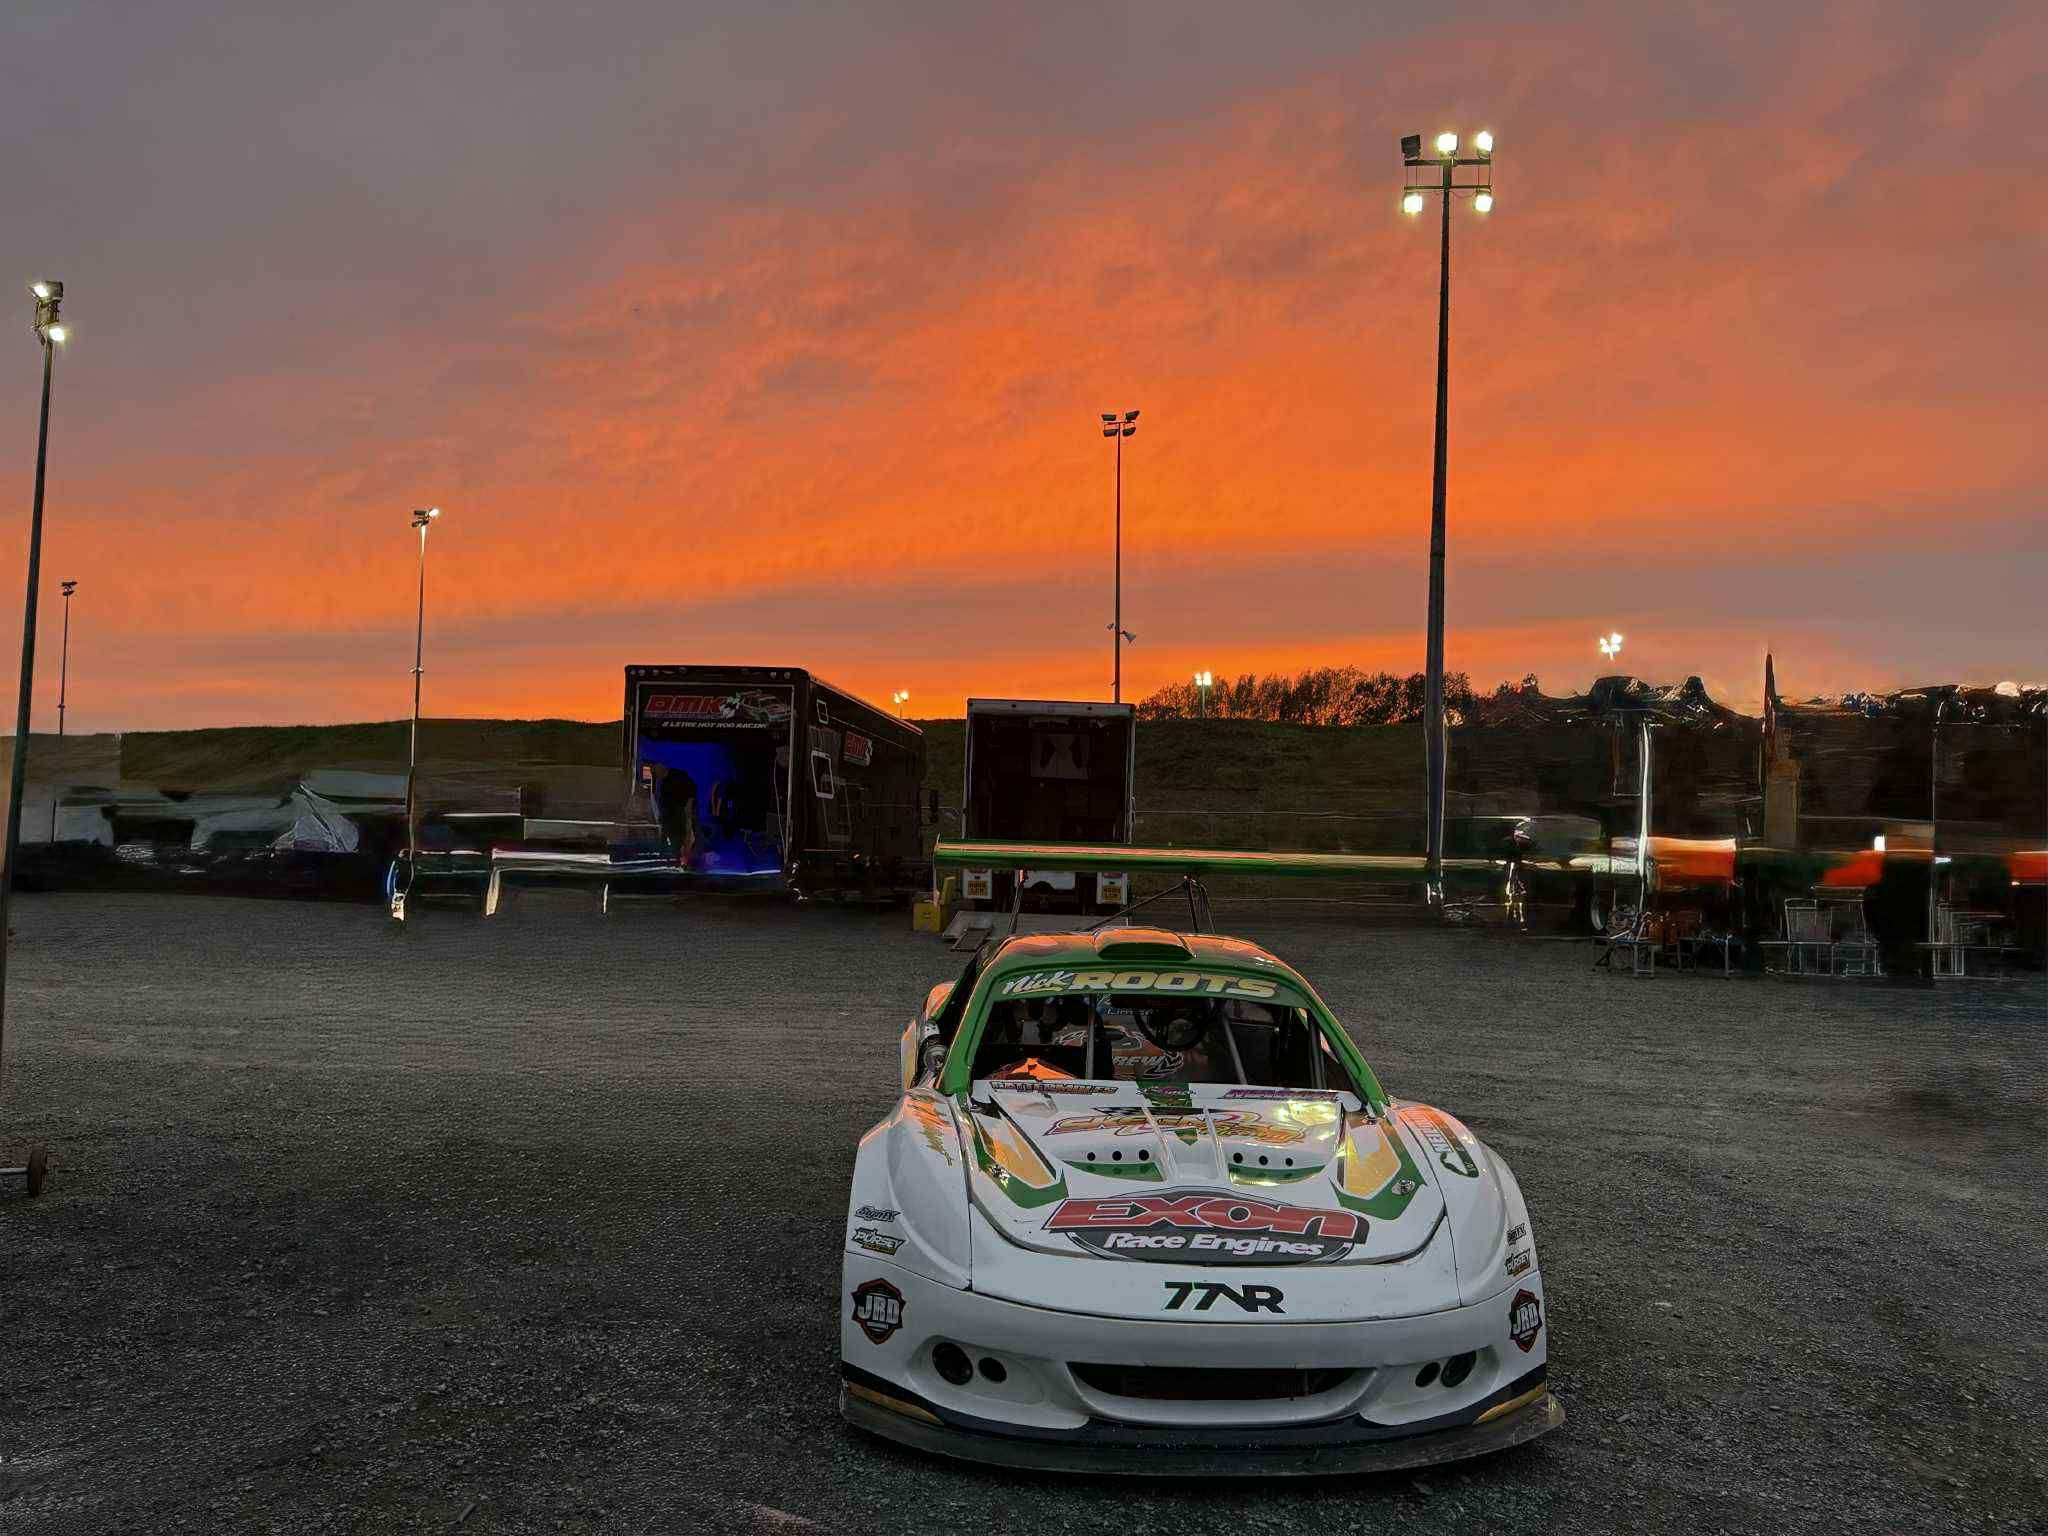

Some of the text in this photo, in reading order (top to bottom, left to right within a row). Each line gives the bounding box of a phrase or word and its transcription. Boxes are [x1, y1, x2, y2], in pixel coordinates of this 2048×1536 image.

[1002, 971, 1278, 998] Nick ROOTS
[1102, 1233, 1325, 1256] Race Engines
[857, 1295, 900, 1325] JRD
[1512, 1302, 1539, 1335] JRD
